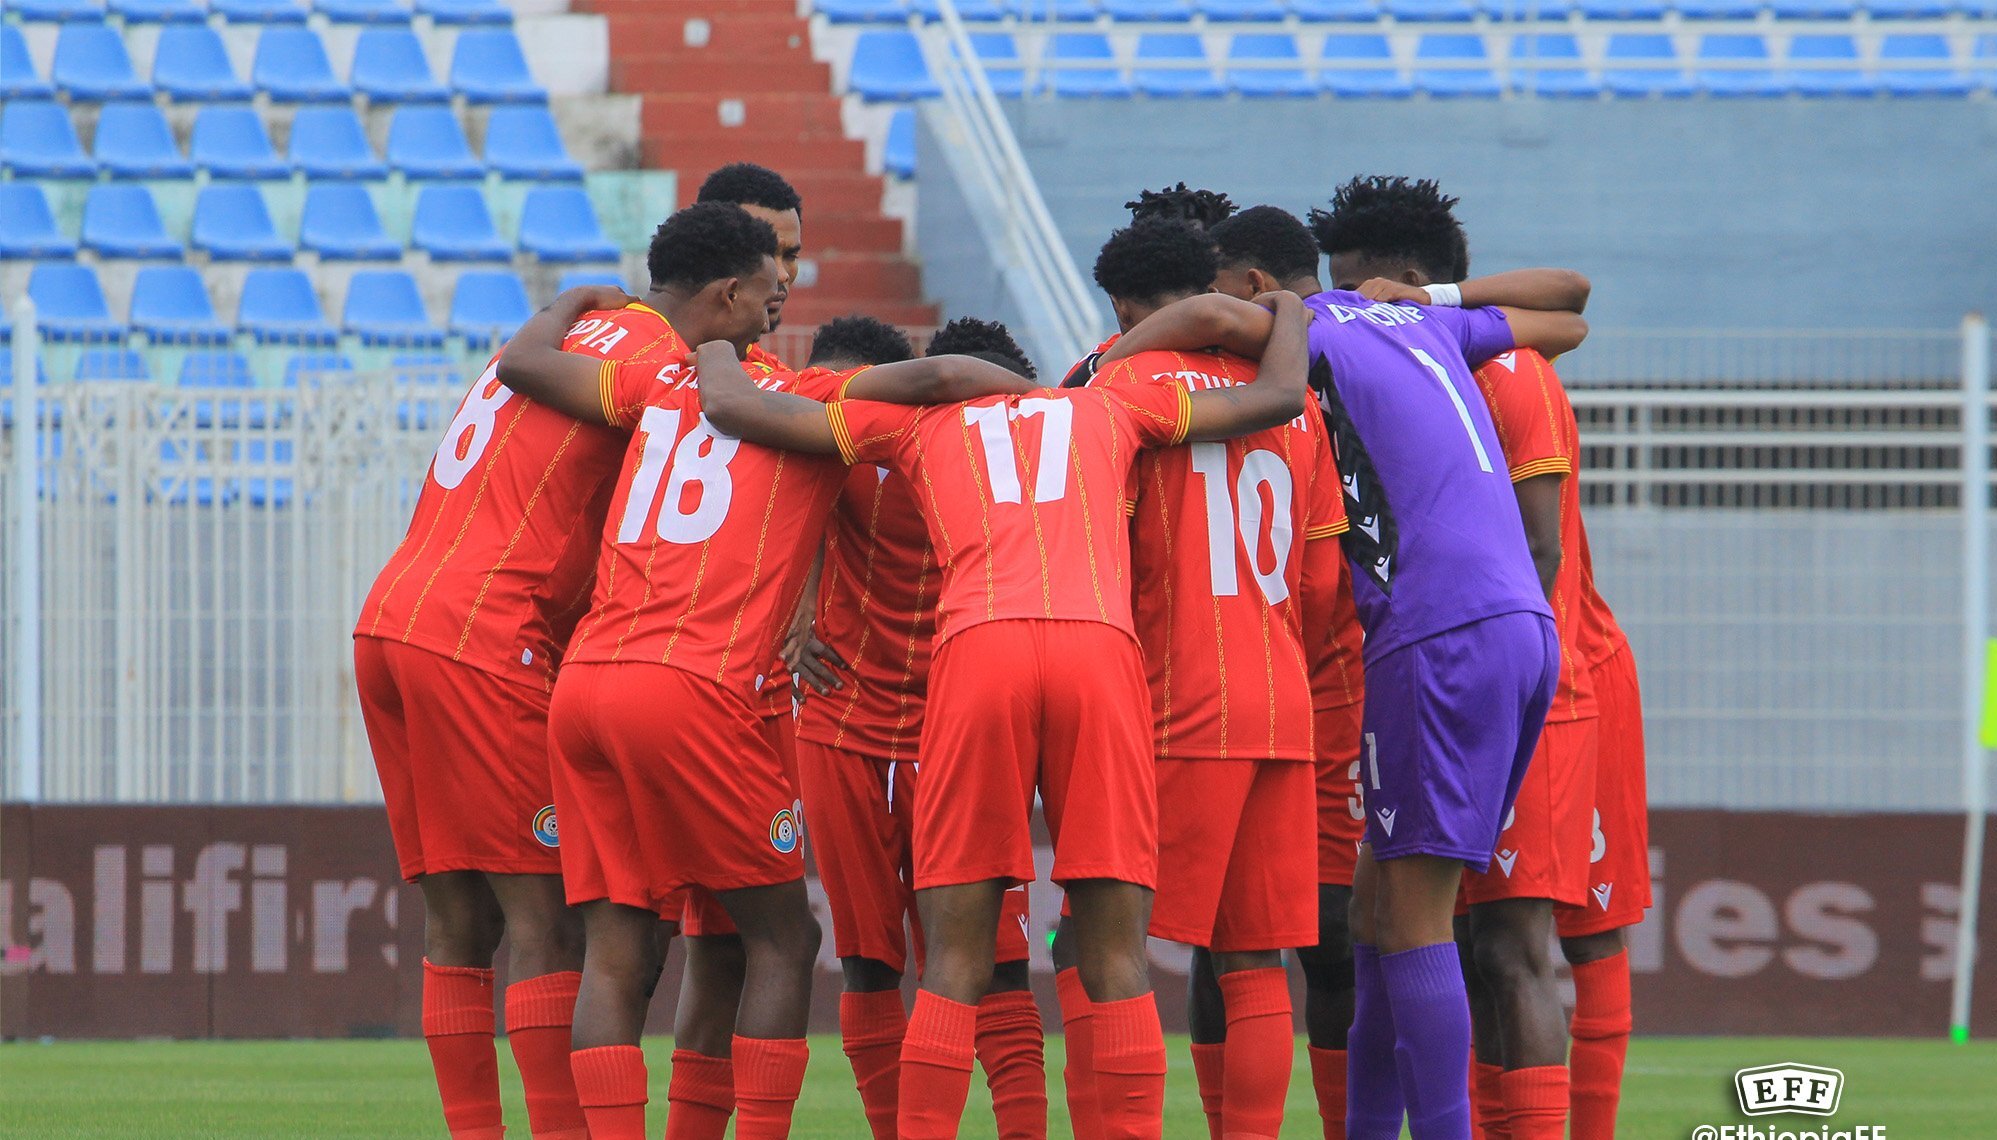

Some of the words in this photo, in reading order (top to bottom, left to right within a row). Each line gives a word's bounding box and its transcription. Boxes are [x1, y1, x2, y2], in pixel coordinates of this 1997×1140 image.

[434, 360, 514, 490] 8
[963, 396, 1074, 505] 17
[1408, 347, 1494, 473] 1
[618, 407, 741, 544] 18
[1191, 442, 1293, 606] 10
[1365, 732, 1381, 790] 1
